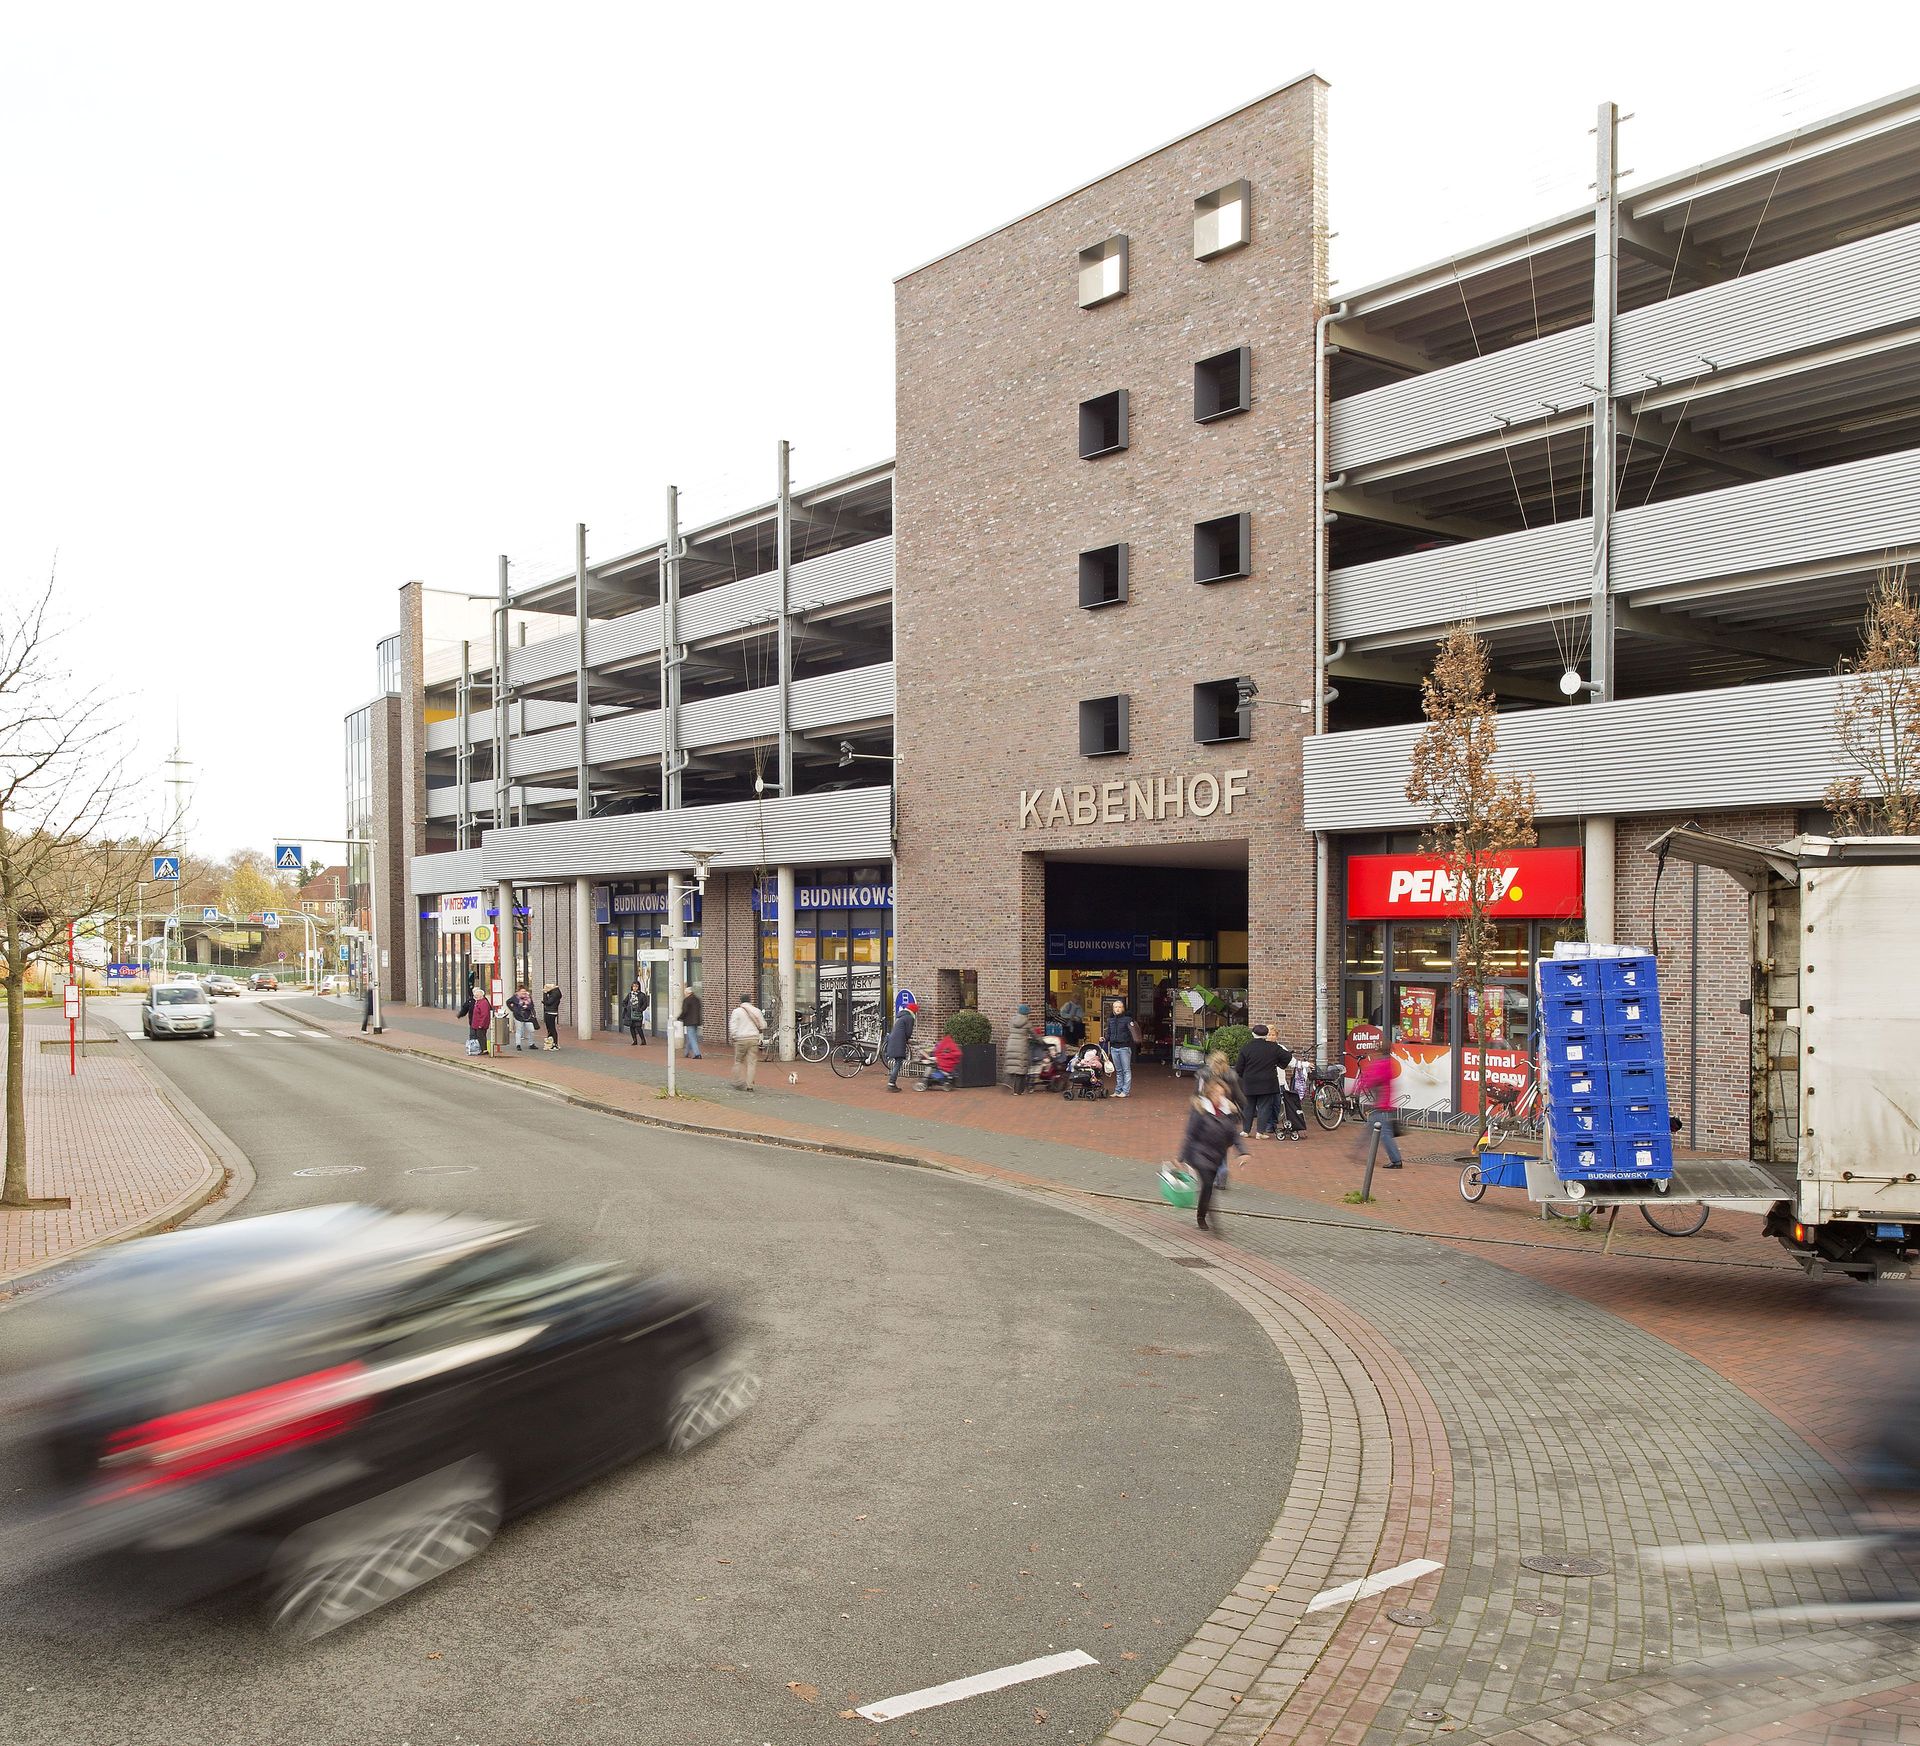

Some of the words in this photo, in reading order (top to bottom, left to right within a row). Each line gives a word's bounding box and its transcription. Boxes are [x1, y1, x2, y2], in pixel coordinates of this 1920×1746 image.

[1019, 769, 1248, 829] KABENHOF
[1067, 940, 1132, 949] BUDNIKOWSKY
[1353, 1032, 1368, 1040] kühl
[1463, 1069, 1479, 1081] zu
[1485, 1069, 1526, 1088] Penny
[1588, 1172, 1648, 1180] BUDNIKOWSKY
